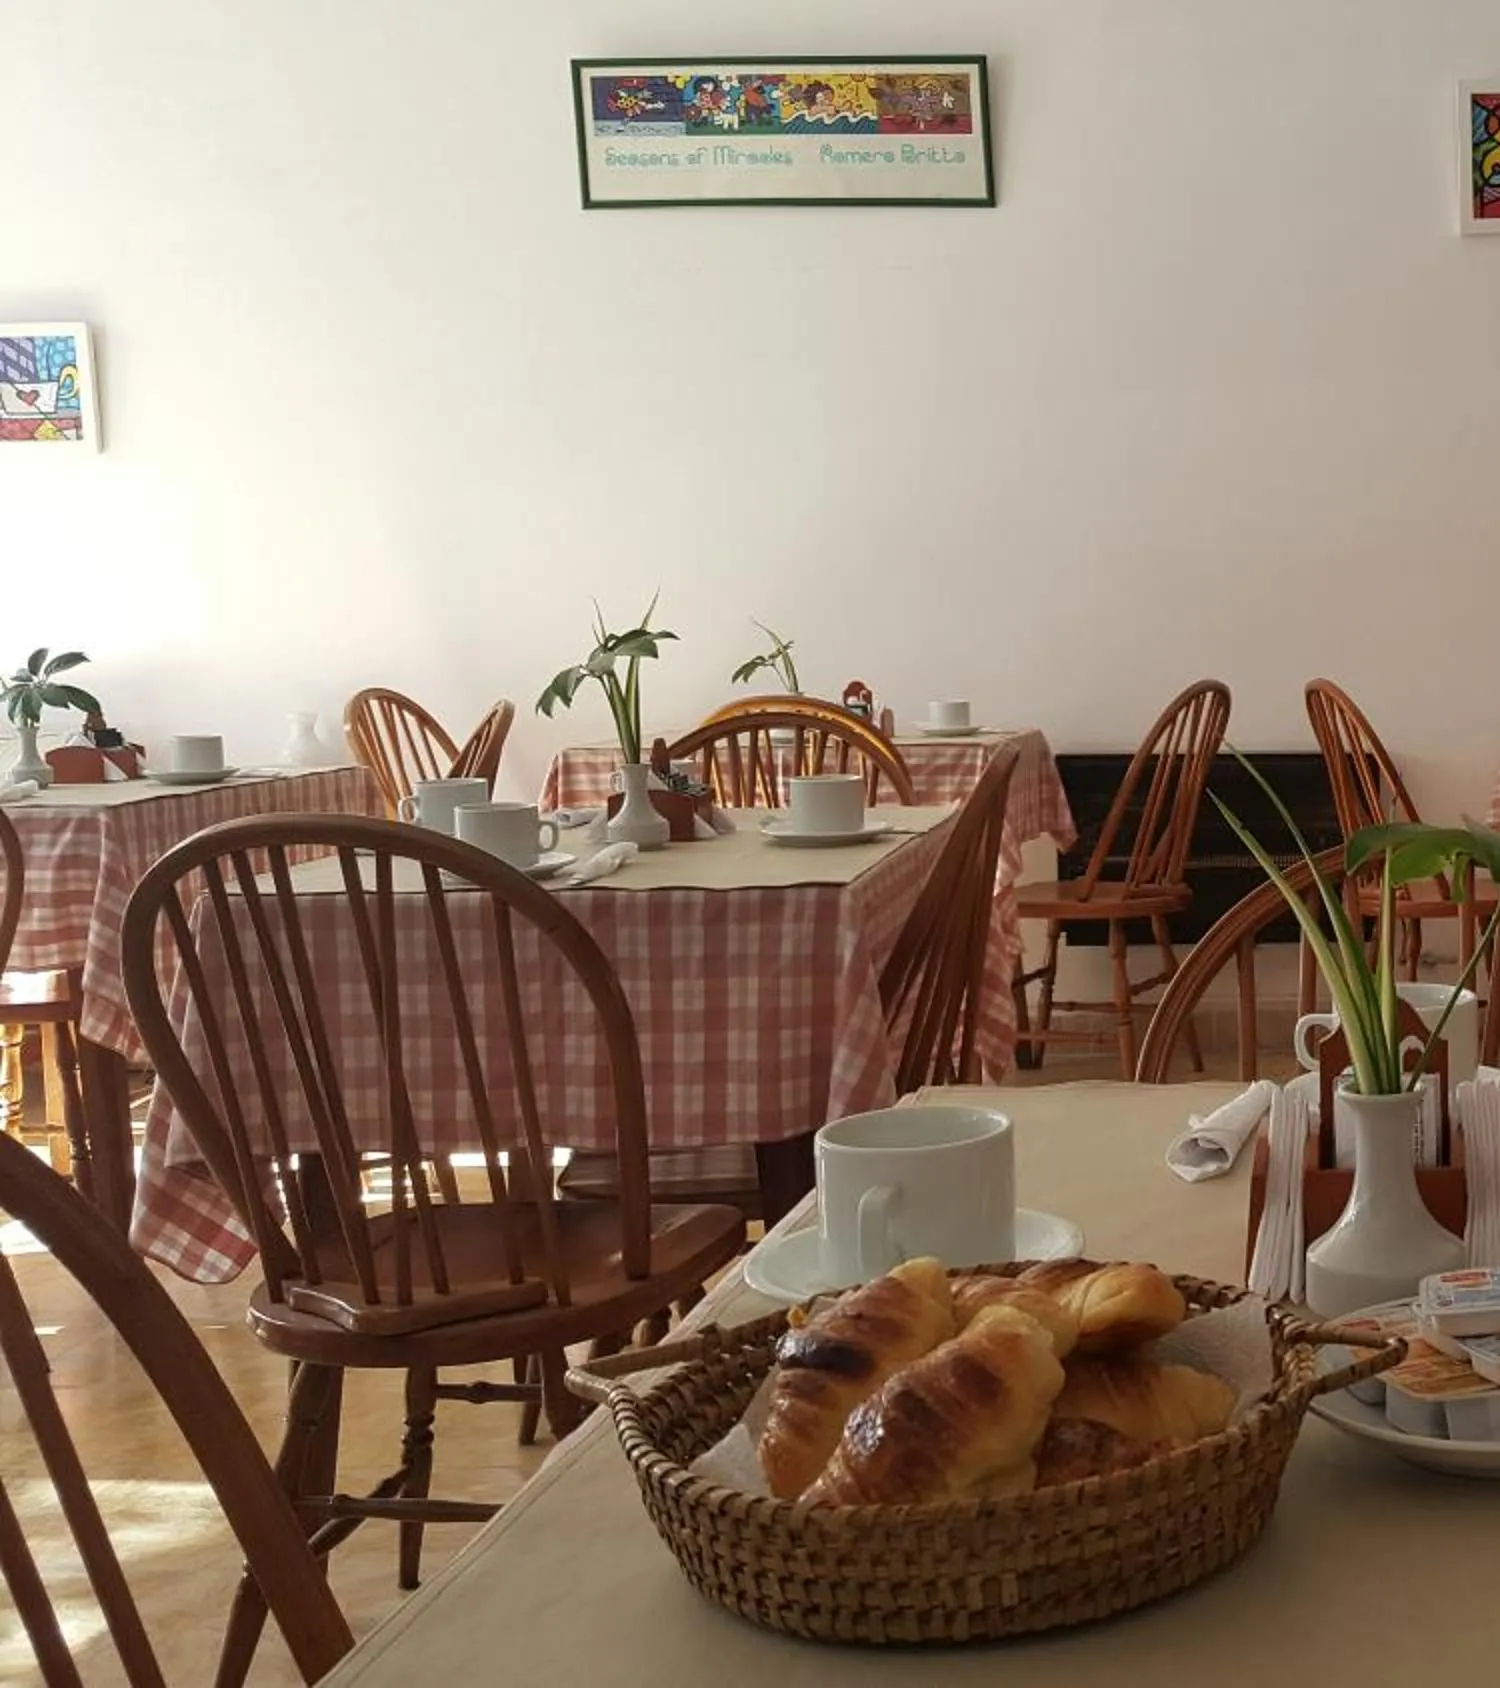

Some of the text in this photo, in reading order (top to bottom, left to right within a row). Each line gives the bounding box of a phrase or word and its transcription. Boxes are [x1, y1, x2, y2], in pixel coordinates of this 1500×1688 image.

[604, 145, 793, 167] Seasons of Miracles
[901, 143, 966, 165] Britto
